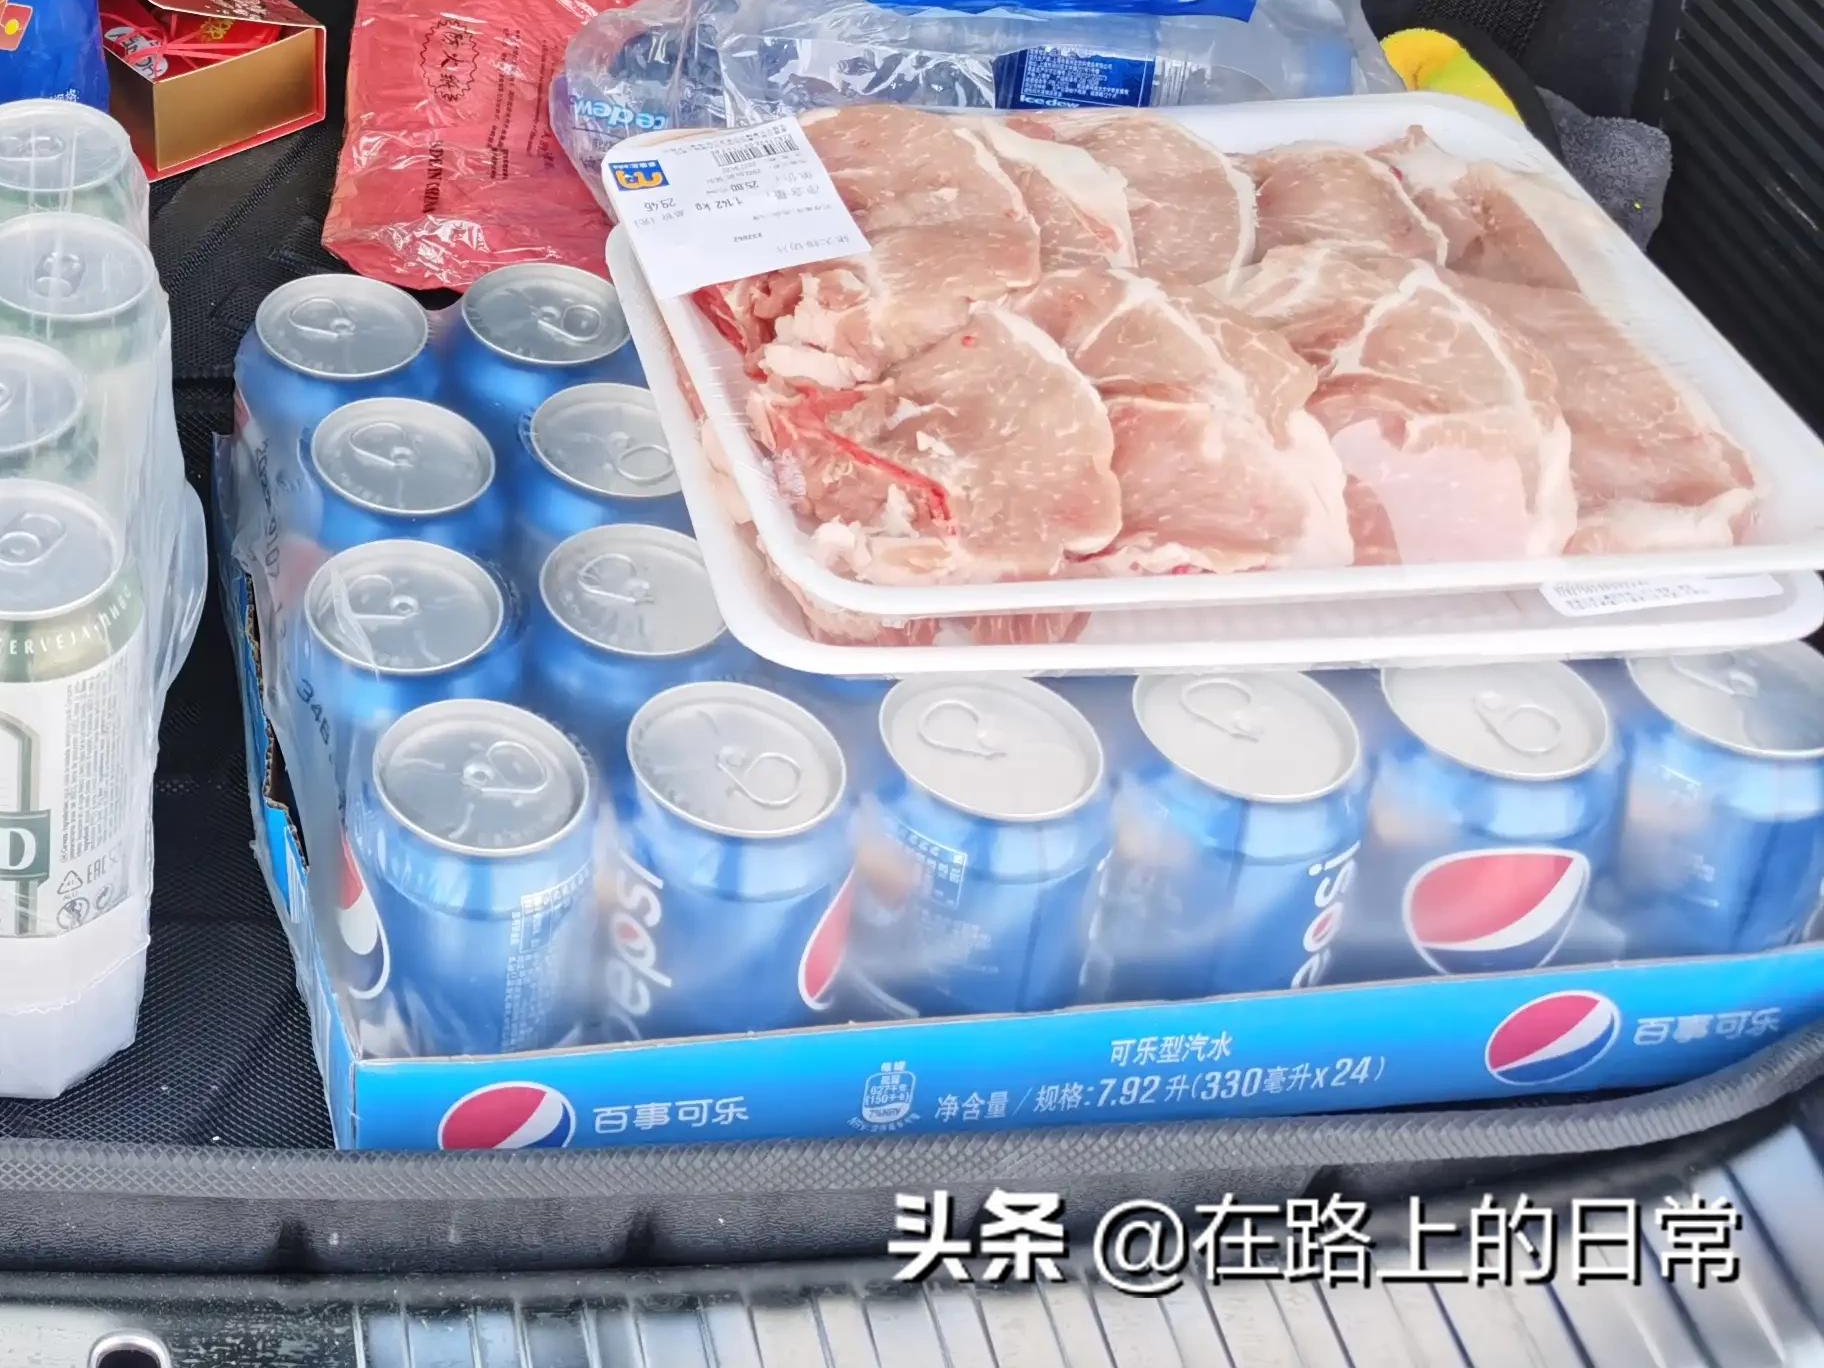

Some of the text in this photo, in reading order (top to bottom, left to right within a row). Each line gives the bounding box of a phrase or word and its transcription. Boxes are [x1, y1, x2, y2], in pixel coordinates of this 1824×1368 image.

[573, 100, 666, 130] cedew
[605, 848, 673, 1041] epsi
[1634, 1007, 1781, 1048] 百事可乐
[1109, 1034, 1233, 1065] 可乐型汽水
[592, 1095, 749, 1134] 百事可乐
[934, 1089, 1009, 1123] 净含量
